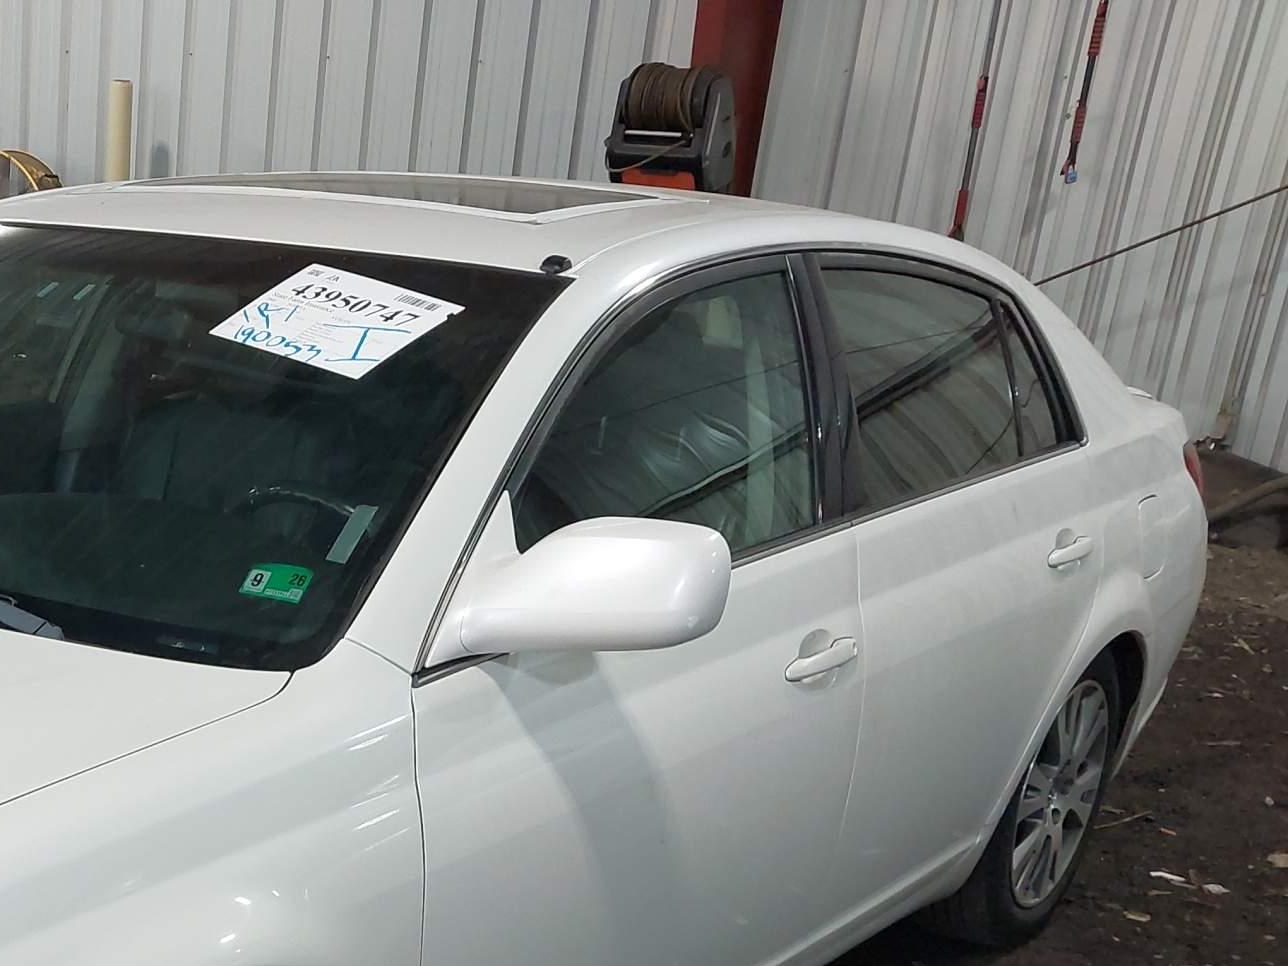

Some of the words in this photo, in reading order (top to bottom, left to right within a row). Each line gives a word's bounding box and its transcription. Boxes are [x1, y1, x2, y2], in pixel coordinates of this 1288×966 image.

[291, 283, 420, 326] 43950747
[251, 573, 264, 587] 9
[288, 573, 308, 587] 26
